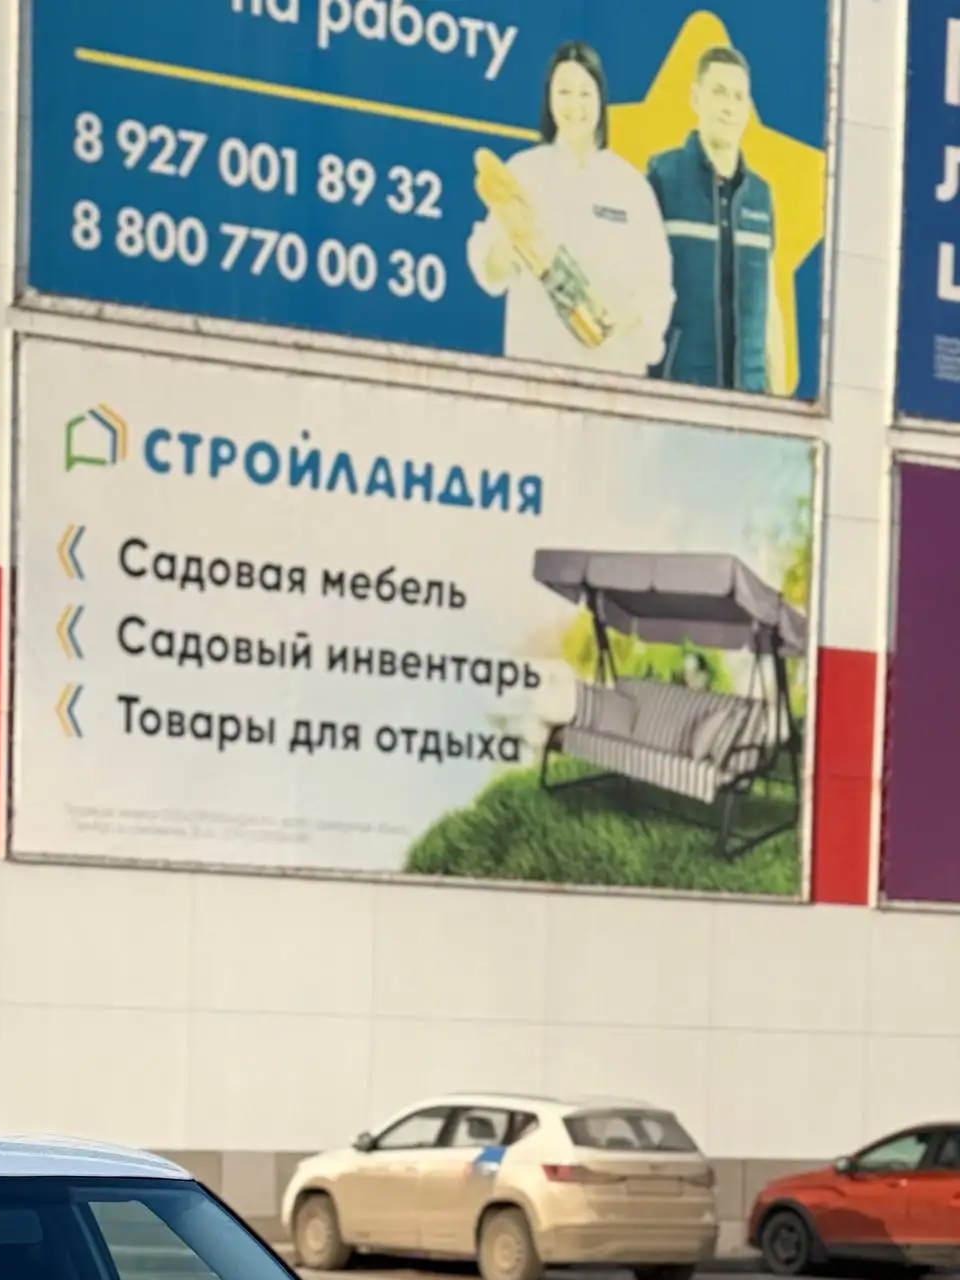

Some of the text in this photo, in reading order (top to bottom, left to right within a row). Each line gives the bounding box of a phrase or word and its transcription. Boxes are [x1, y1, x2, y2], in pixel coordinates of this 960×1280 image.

[318, 0, 518, 80] работу
[74, 112, 442, 219] 8 927 001 89 32
[72, 200, 446, 302] 8 800 770 00 30
[144, 428, 543, 516] СТРОЙЛАНДИЯ
[119, 538, 467, 609] Садовая мебель
[118, 615, 541, 696] Садовый инвентарь
[117, 695, 521, 764] Товары для отдыха
